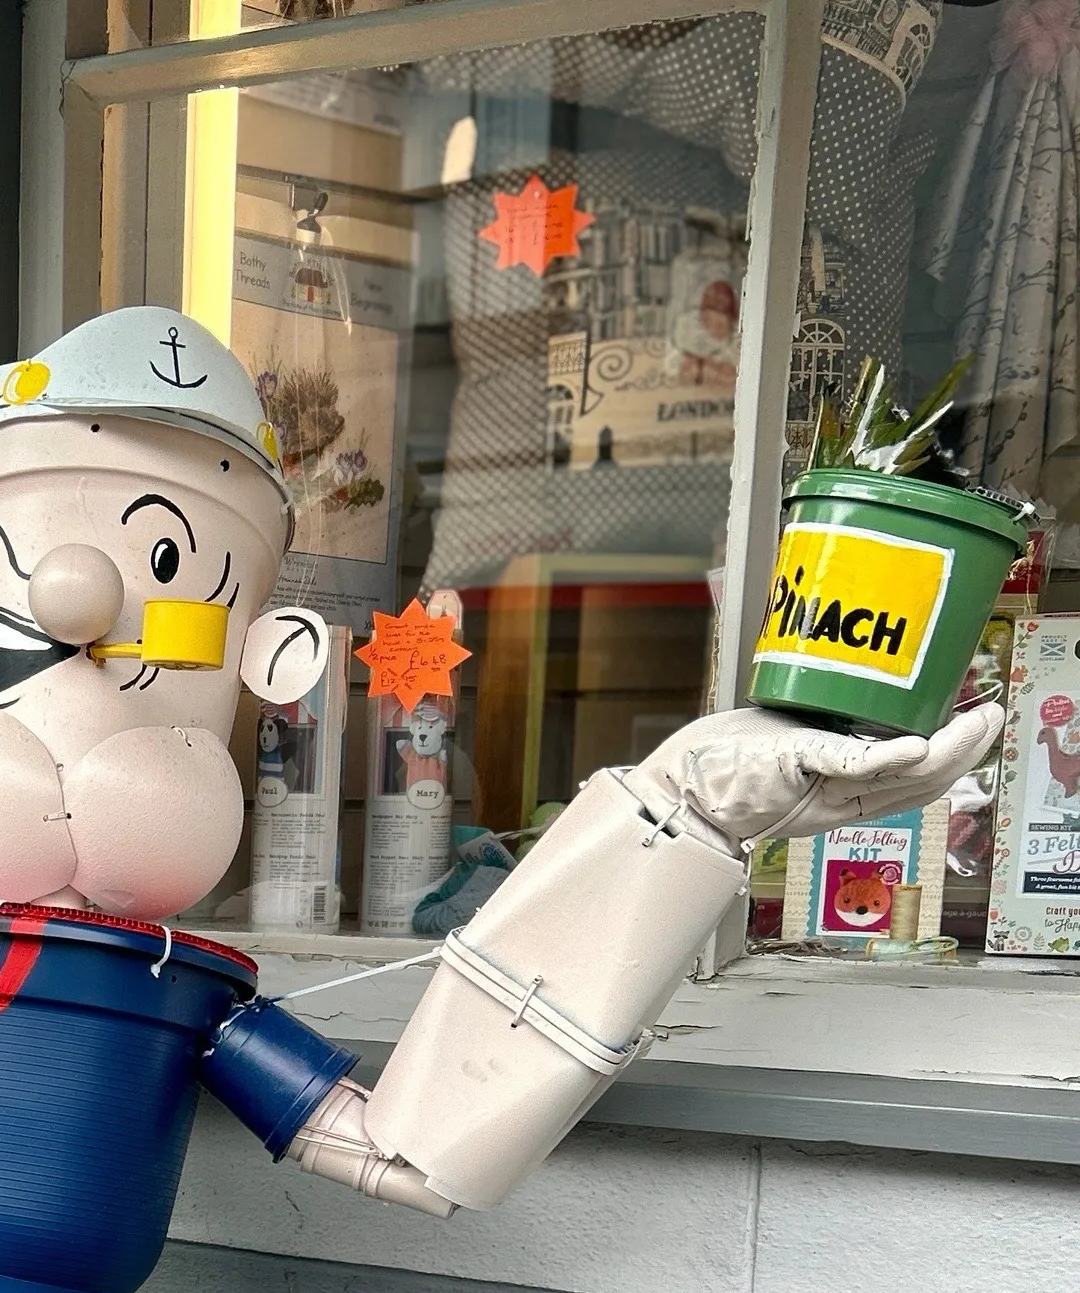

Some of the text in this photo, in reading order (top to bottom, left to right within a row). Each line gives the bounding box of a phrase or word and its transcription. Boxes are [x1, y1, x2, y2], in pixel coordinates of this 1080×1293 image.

[240, 251, 267, 271] Bothy
[235, 269, 271, 290] Threads
[657, 399, 734, 422] LONDO
[760, 565, 908, 656] PiNACH
[261, 786, 278, 795] Paul
[416, 789, 439, 799] Mary
[828, 828, 908, 851] Needle Felting
[1027, 839, 1040, 855] 3
[848, 846, 882, 862] KIT
[1046, 906, 1067, 915] Craft
[1044, 919, 1055, 928] to
